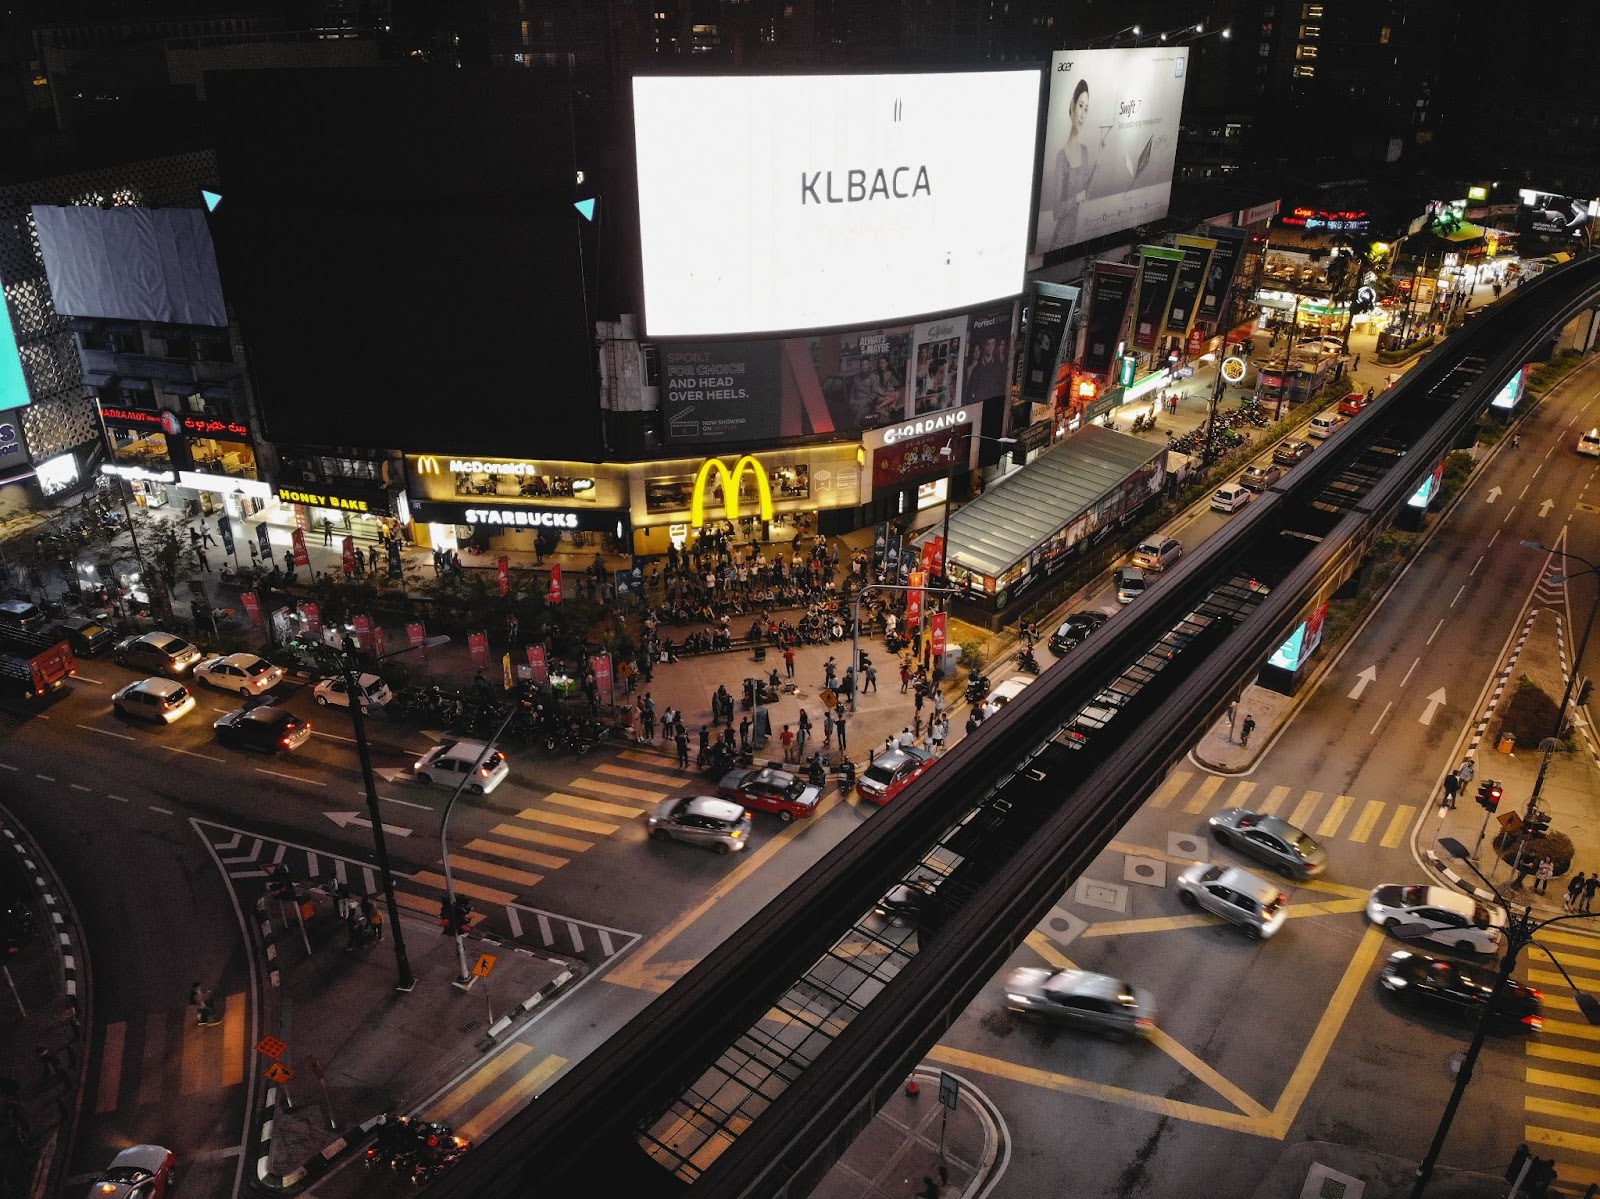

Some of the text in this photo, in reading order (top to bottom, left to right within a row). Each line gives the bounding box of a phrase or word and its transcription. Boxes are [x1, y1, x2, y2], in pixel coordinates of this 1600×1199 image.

[1057, 62, 1074, 72] acer
[1119, 100, 1135, 118] Swift
[802, 165, 931, 205] KLBACA
[974, 318, 996, 329] Perfect
[867, 342, 891, 354] MAYBE
[667, 352, 711, 363] SPOILT
[668, 363, 746, 377] FOR CHOICE
[669, 377, 734, 389] AND HEAD
[669, 388, 750, 402] OVER HEELS.
[884, 411, 968, 444] GIORDANO
[449, 460, 536, 475] McDonald's
[279, 488, 326, 506] HONEY
[329, 496, 368, 512] BAKE
[465, 509, 579, 527] STARBUCKS
